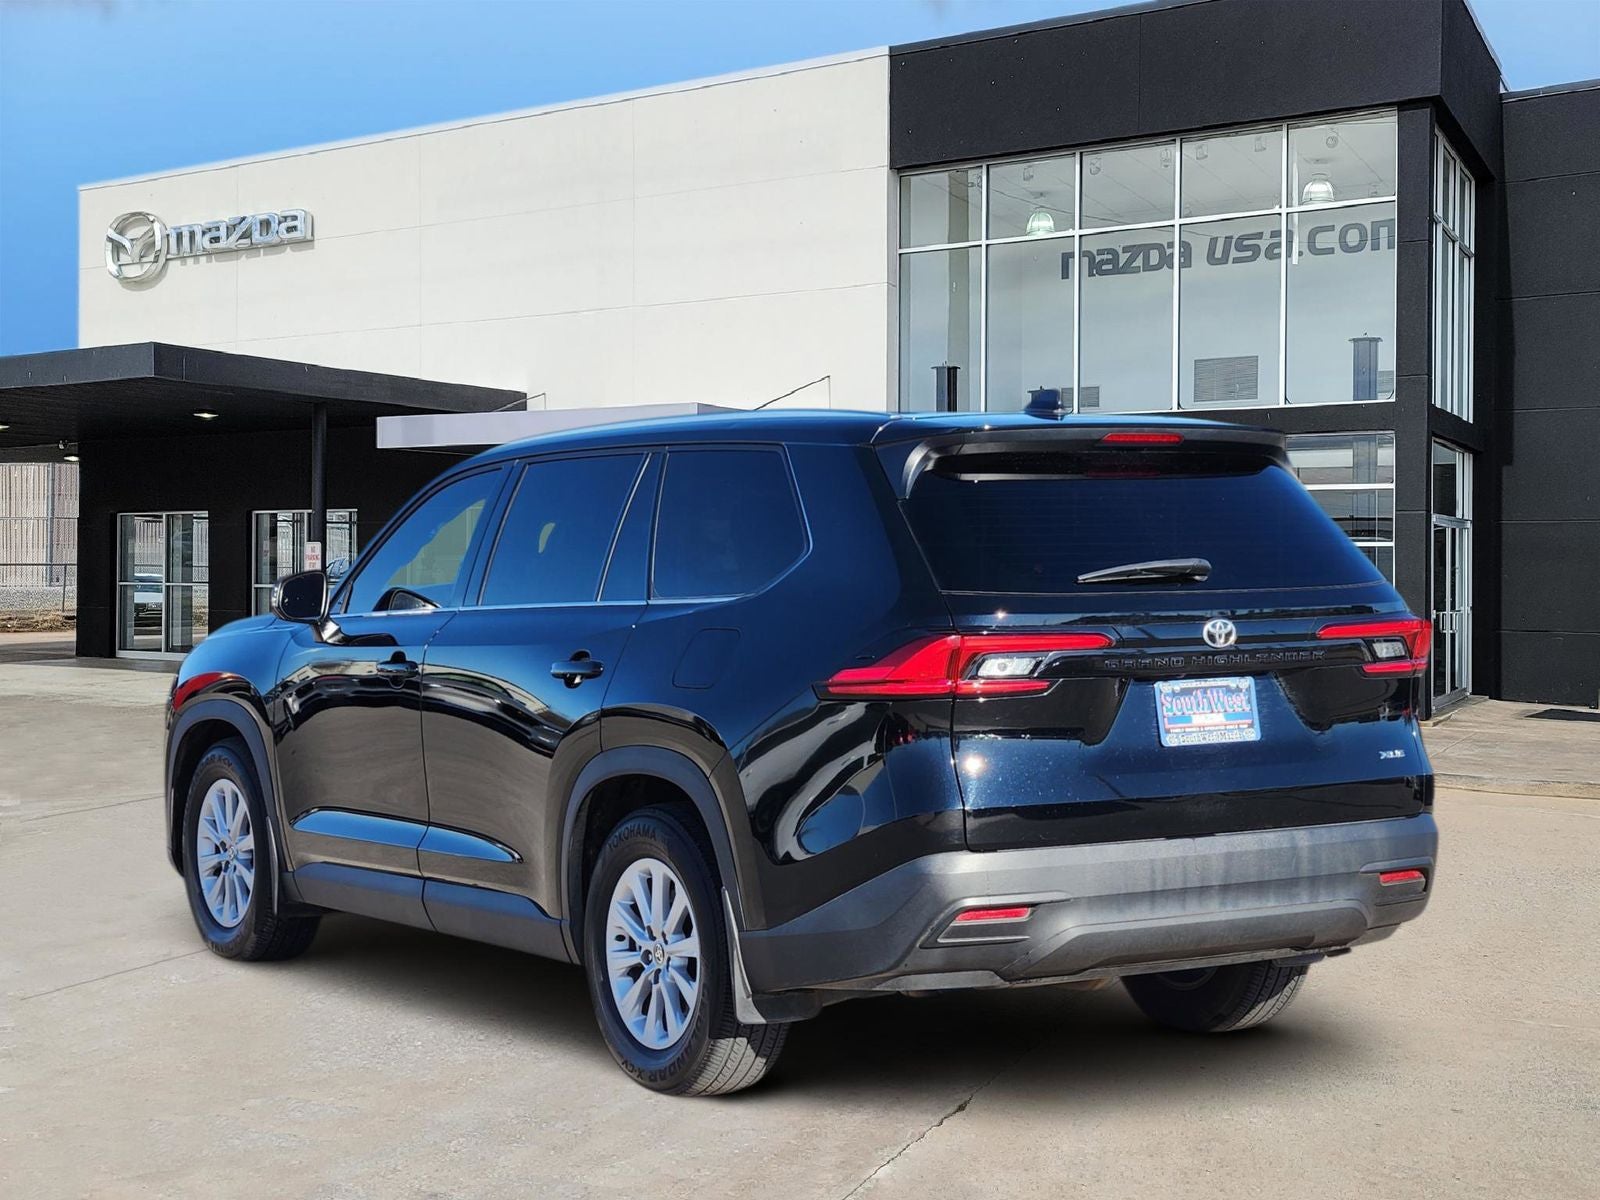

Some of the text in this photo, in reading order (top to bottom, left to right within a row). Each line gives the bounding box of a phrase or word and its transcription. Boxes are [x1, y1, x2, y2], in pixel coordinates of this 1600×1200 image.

[1061, 240, 1192, 280] mazda
[1104, 650, 1326, 668] GRAND HIGHLANDER
[607, 823, 657, 851] YOKOHAMA
